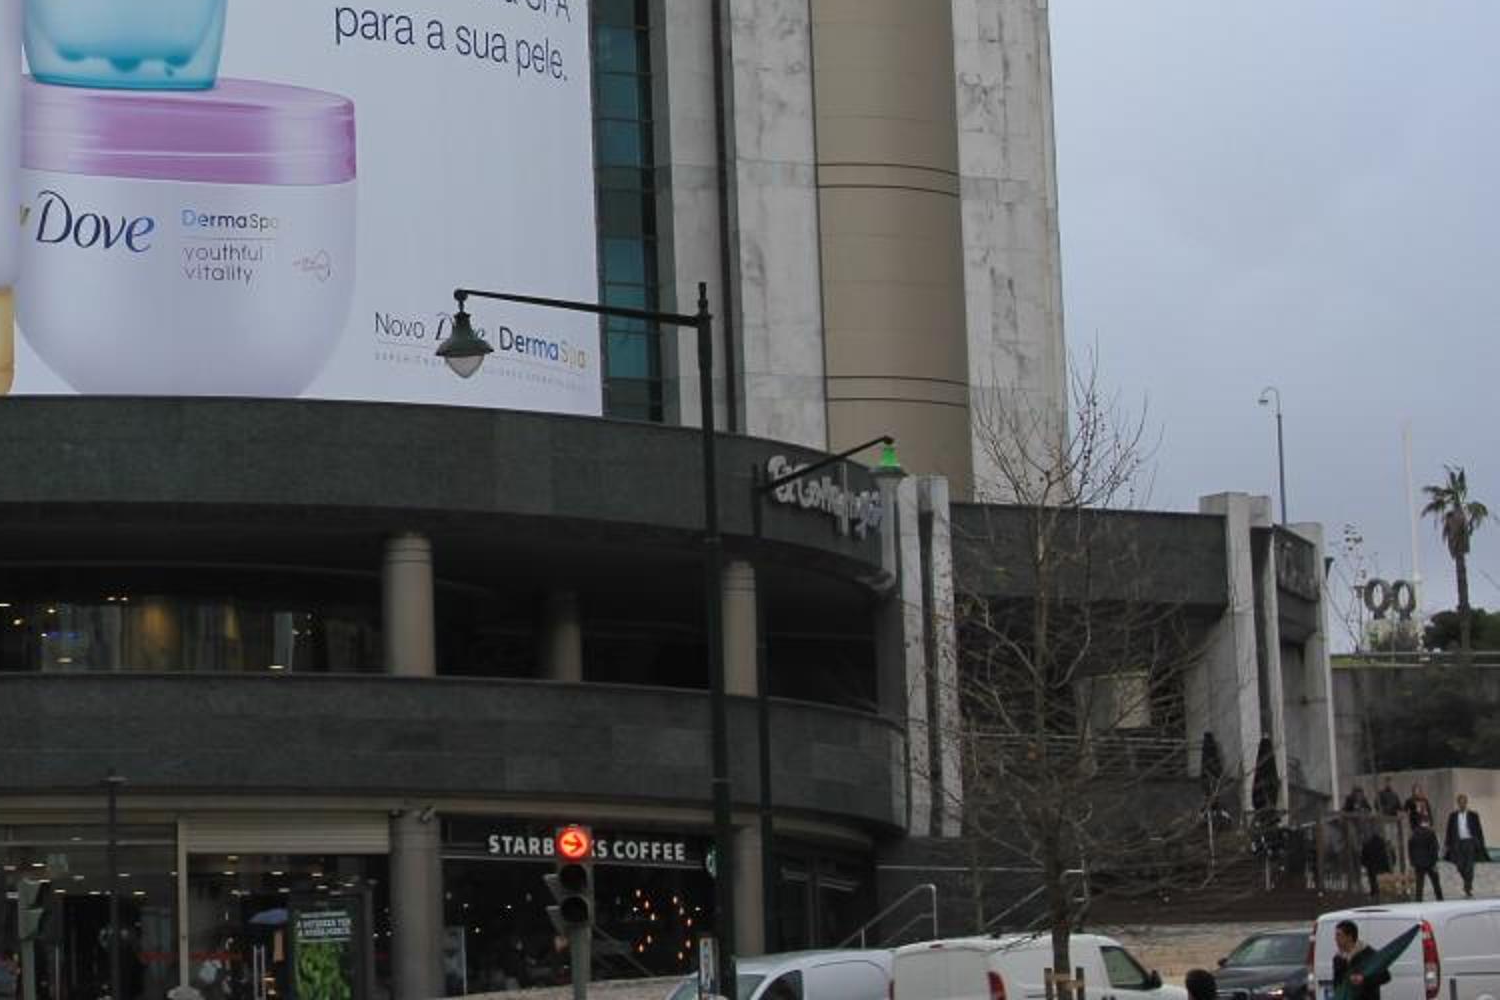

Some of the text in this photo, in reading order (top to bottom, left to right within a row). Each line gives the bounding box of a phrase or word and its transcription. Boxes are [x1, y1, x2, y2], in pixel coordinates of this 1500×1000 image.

[335, 5, 568, 82] para a sua pele.
[36, 190, 156, 253] Dove
[182, 243, 263, 267] youthful
[184, 264, 254, 284] vitality
[375, 312, 425, 339] Novo
[488, 835, 685, 861] STARBS COFFEE
